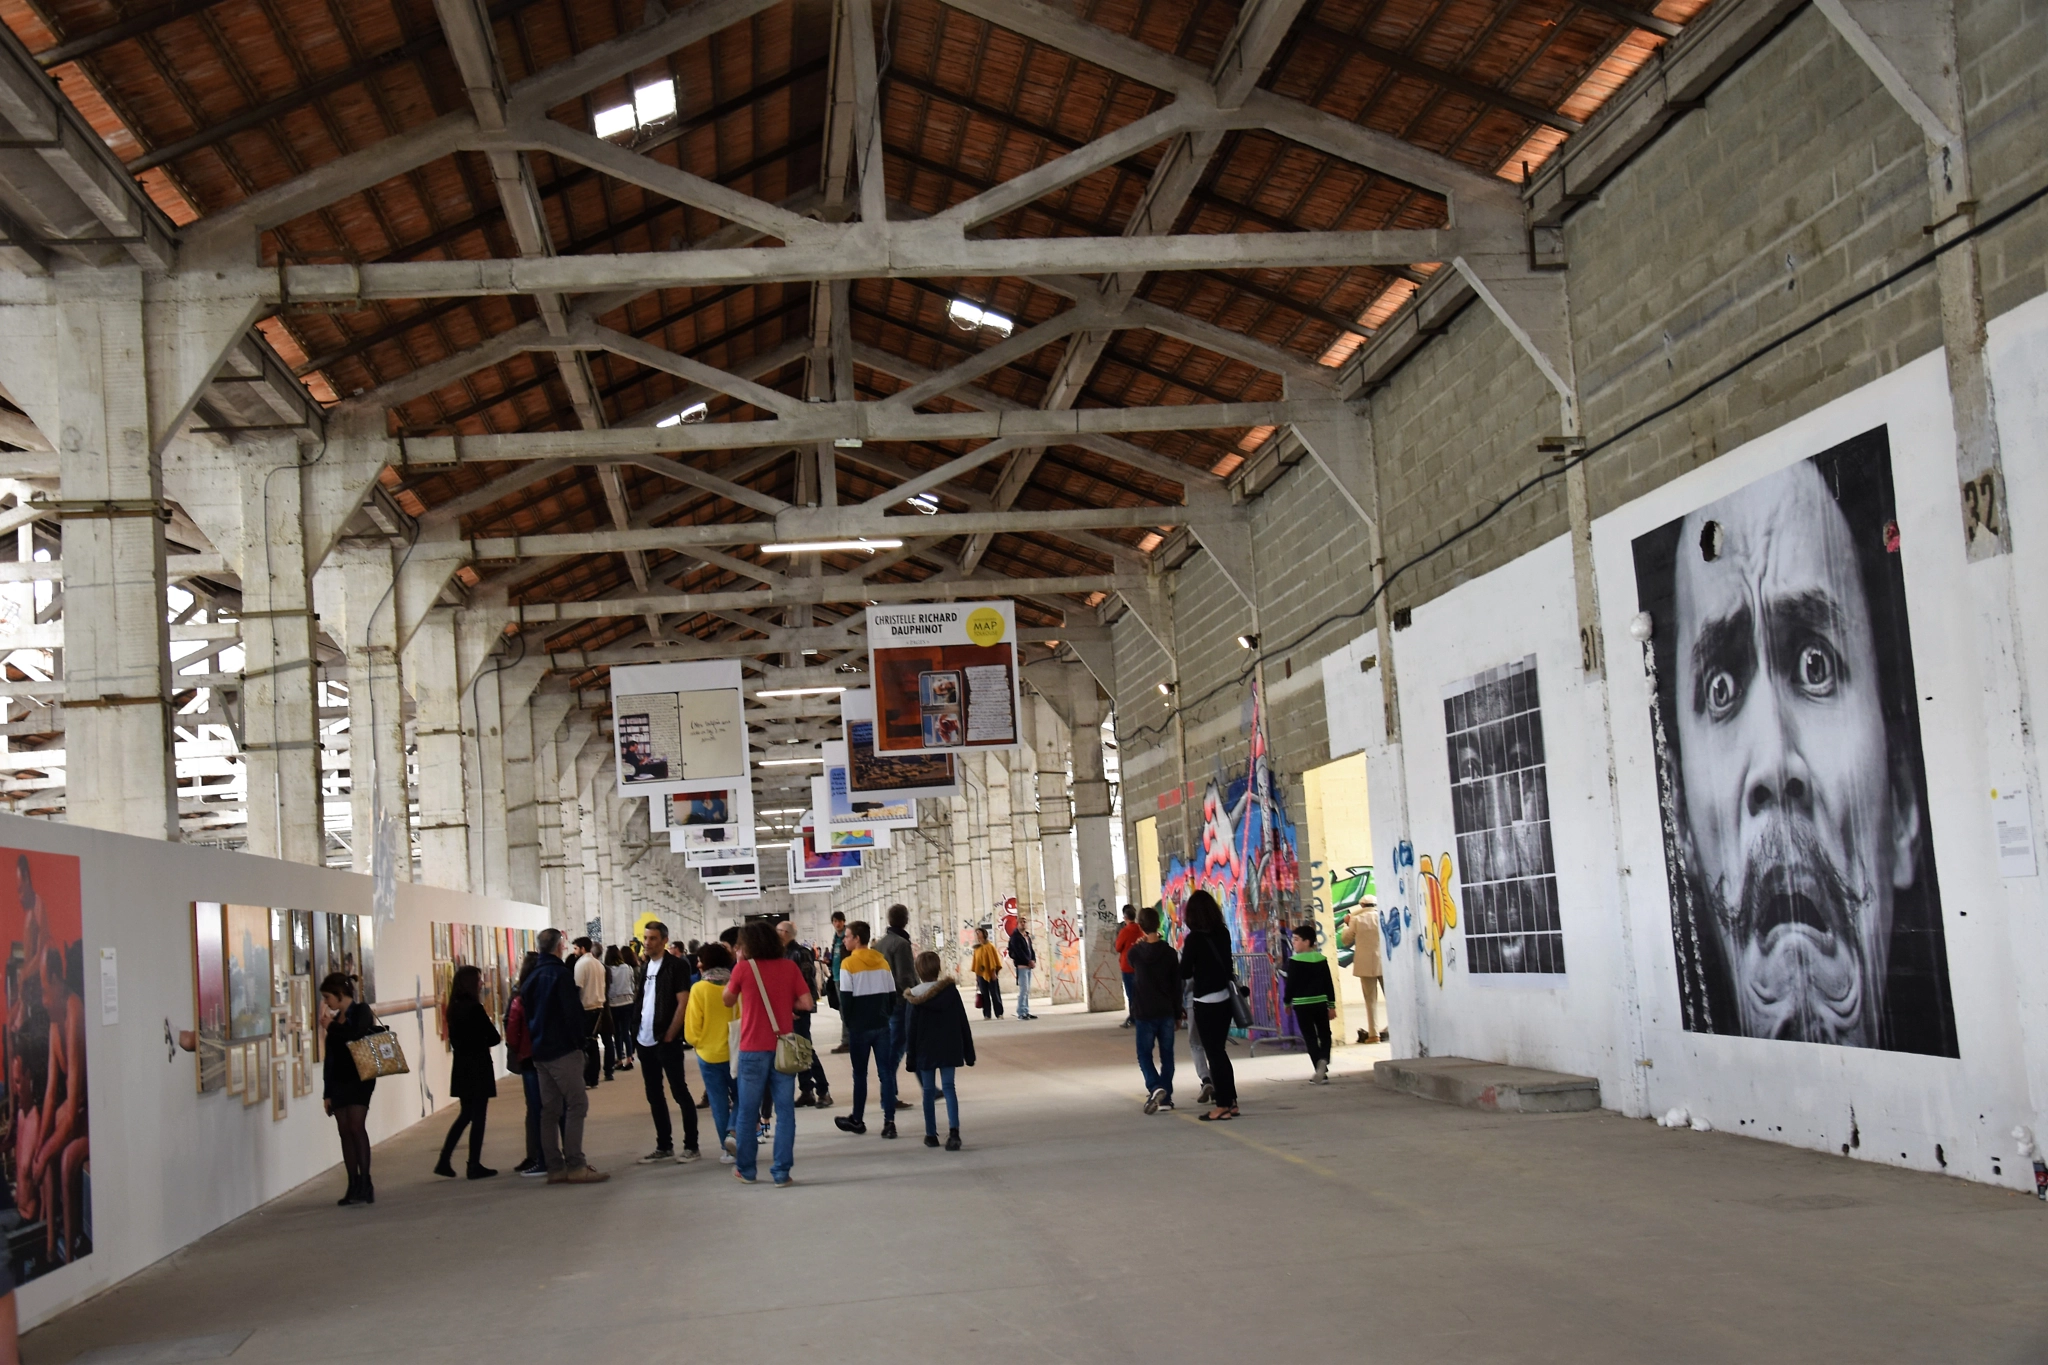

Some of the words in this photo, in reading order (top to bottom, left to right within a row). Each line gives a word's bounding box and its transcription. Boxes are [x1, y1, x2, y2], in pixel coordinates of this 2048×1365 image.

[874, 614, 916, 626] CHRISTELLE
[918, 612, 958, 623] RICHARD
[891, 624, 943, 636] DAUPHINOT
[973, 621, 998, 631] MAP
[1581, 624, 1597, 671] 31
